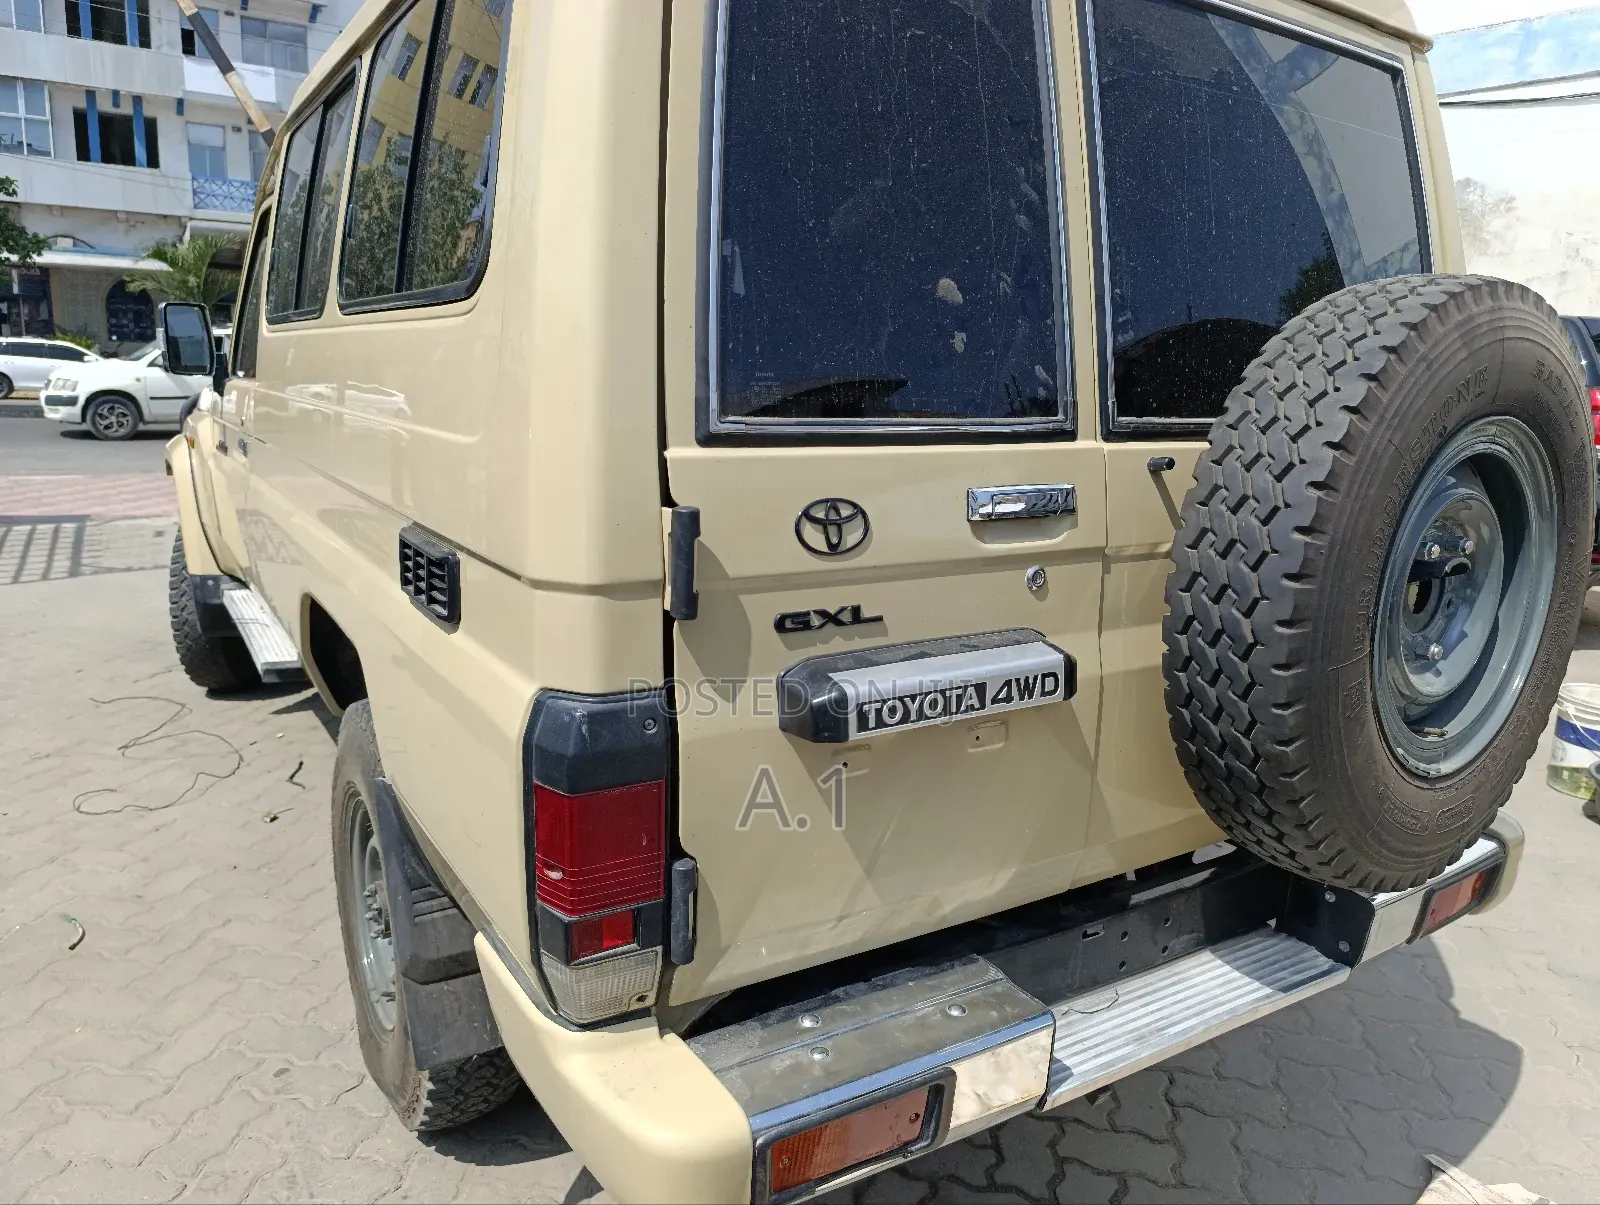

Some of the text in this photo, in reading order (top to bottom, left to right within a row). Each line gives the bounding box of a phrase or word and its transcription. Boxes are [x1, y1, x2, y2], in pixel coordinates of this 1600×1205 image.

[773, 604, 884, 633] GXL
[862, 671, 1061, 730] TOYOTA 4WD
